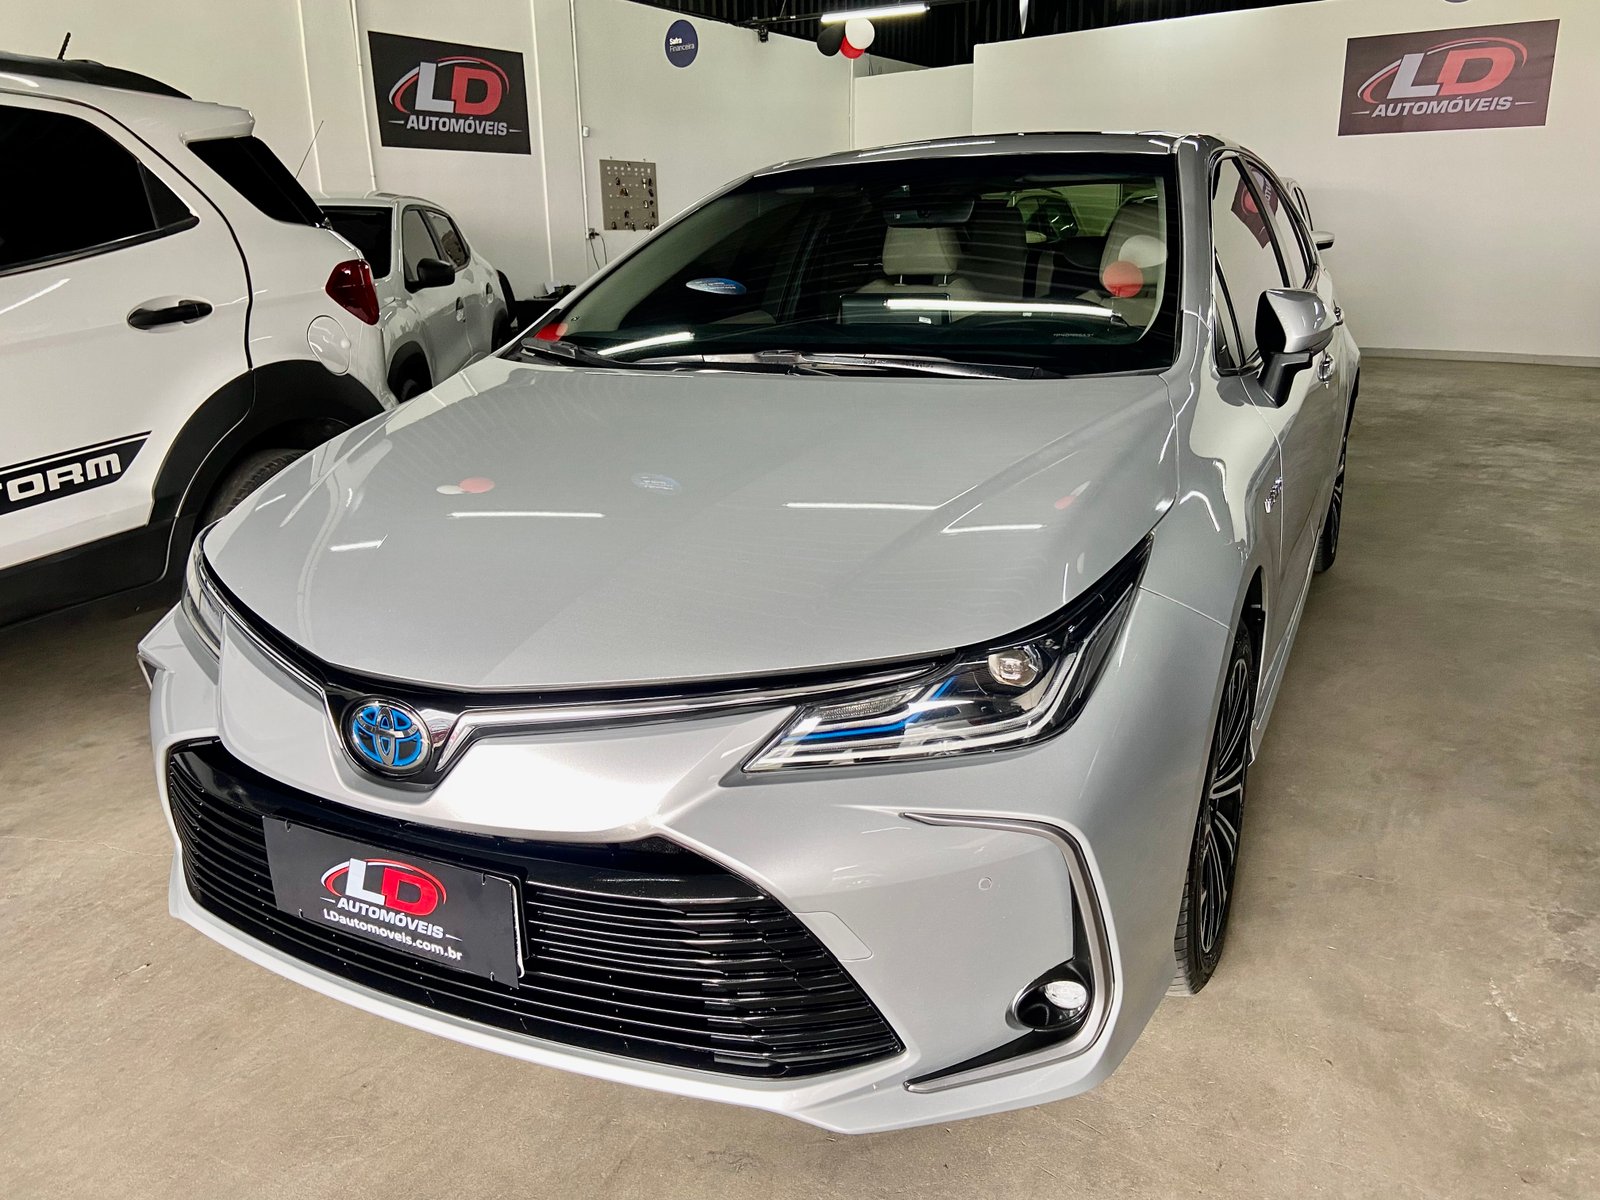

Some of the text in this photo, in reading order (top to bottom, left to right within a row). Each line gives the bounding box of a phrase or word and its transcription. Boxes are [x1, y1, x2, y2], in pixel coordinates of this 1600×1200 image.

[669, 37, 683, 45] Safra
[669, 43, 695, 52] Financeira
[414, 61, 503, 116] LD
[1386, 47, 1516, 99] LD
[406, 114, 508, 136] AUTOMÓVEIS
[1371, 96, 1513, 118] AUTOMÓVEIS
[0, 452, 122, 502] ORM
[345, 858, 439, 916] LD
[323, 908, 463, 961] LDautomoveis.com.br
[337, 897, 445, 939] AUTOMÓVEIS
